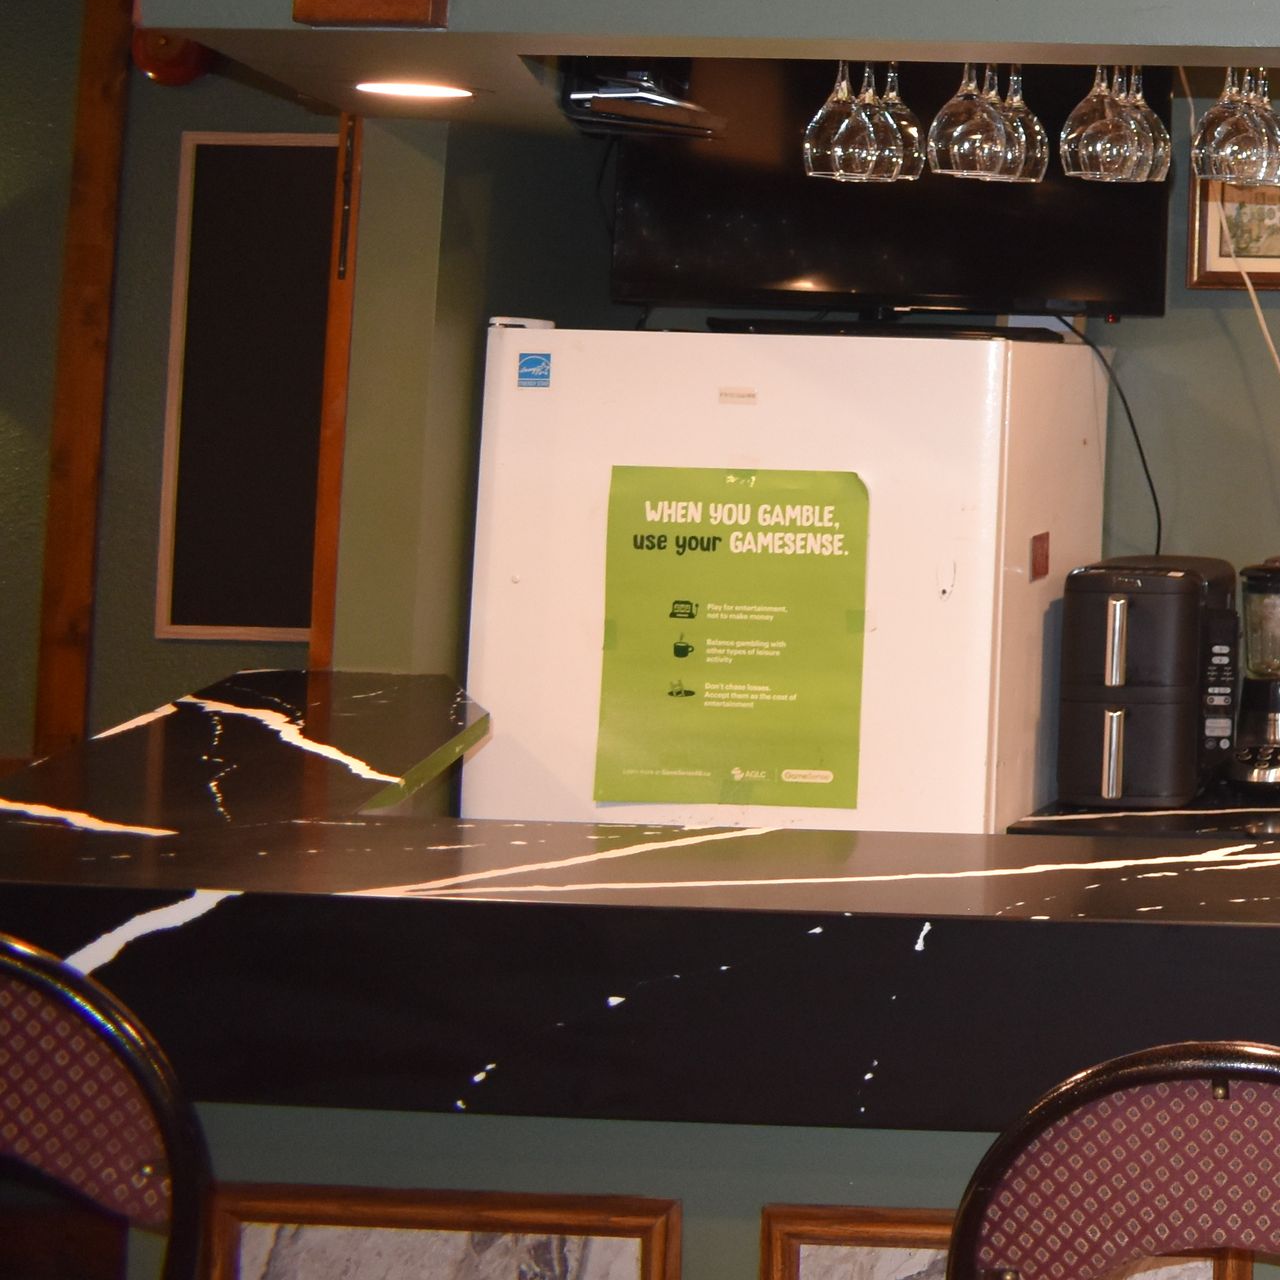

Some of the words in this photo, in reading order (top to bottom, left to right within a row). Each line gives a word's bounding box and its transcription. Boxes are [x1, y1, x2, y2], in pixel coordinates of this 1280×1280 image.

[645, 500, 703, 523] WHEN
[709, 503, 751, 525] YOU
[758, 504, 840, 530] GAMBLE,
[633, 534, 667, 550] use
[675, 534, 722, 556] your
[729, 531, 849, 556] GAMESENSE.
[749, 614, 774, 622] money
[735, 640, 769, 649] gambling
[770, 640, 787, 648] with
[726, 648, 746, 657] types
[706, 656, 733, 664] activity
[772, 693, 788, 701] cost
[788, 693, 797, 701] of
[703, 700, 754, 708] entertainment
